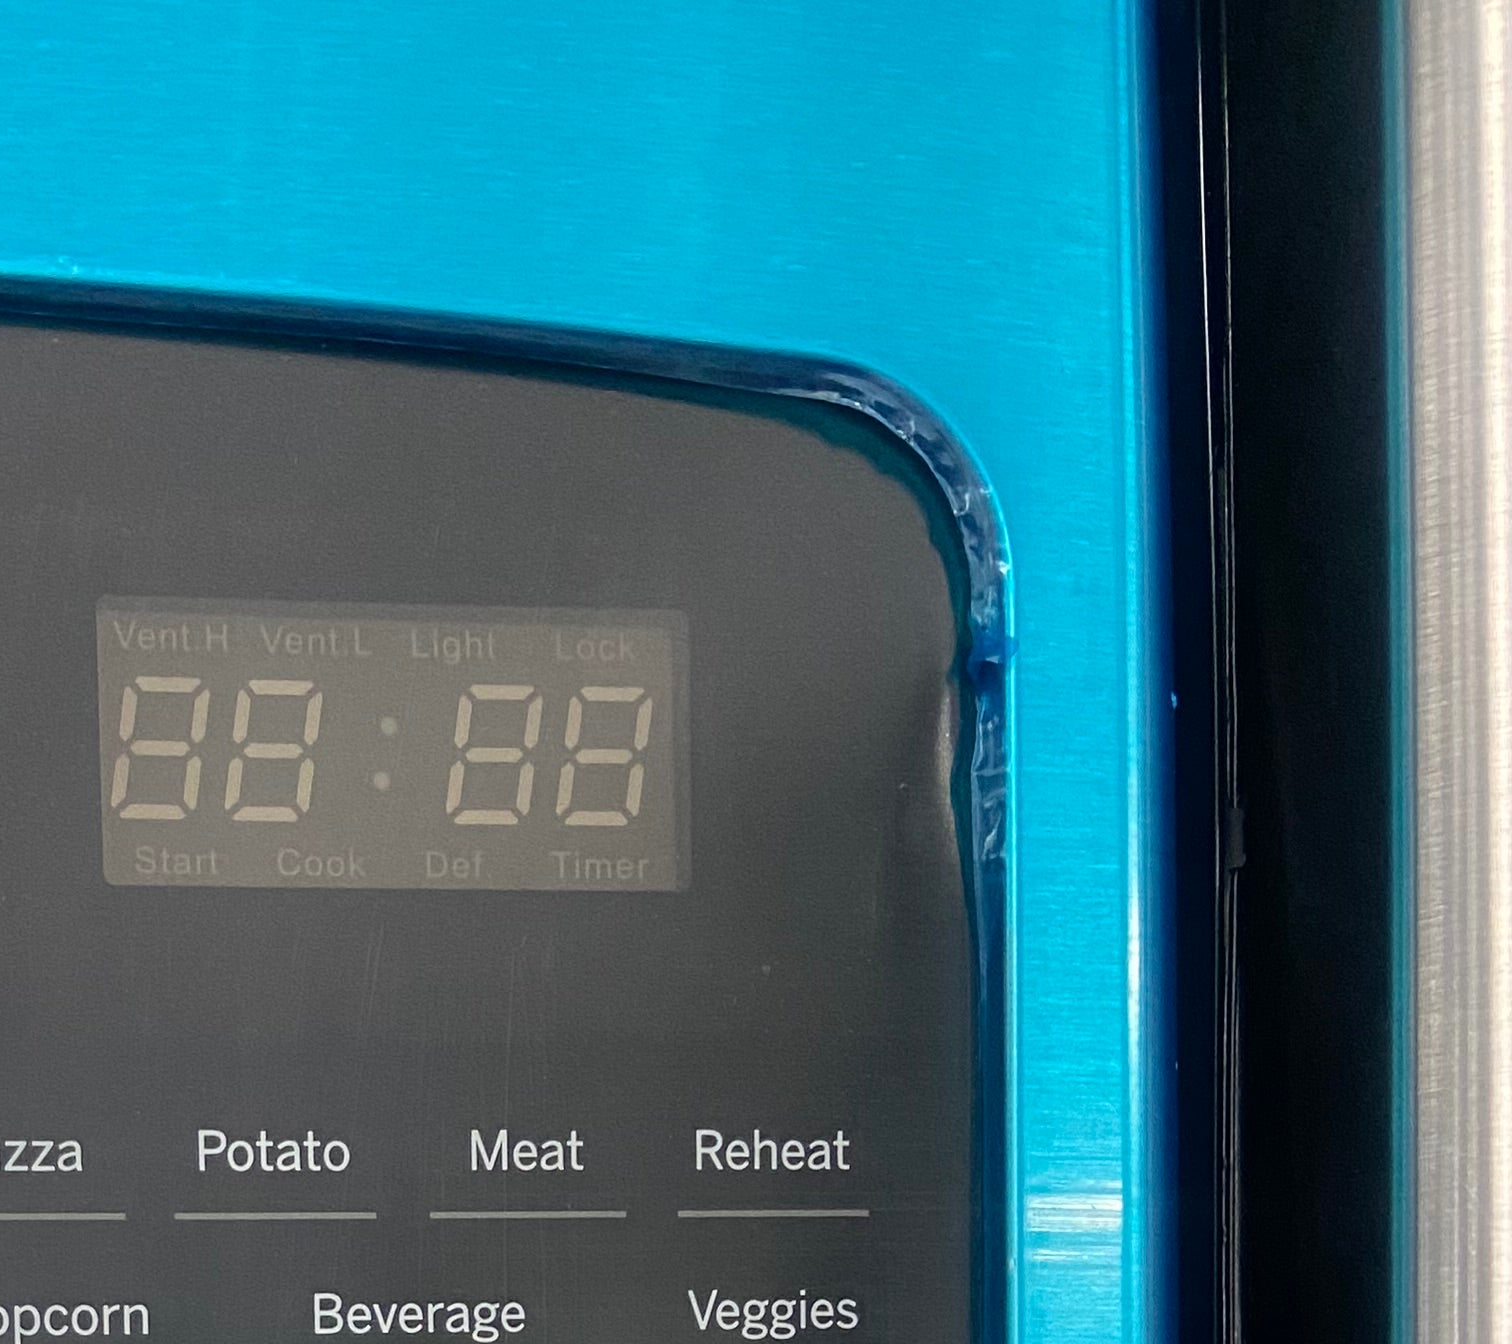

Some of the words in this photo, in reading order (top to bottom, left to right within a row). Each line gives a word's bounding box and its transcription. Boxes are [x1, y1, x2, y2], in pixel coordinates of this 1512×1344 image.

[410, 628, 496, 665] Light
[555, 631, 637, 661] Lock
[134, 845, 219, 875] Start
[276, 846, 367, 877] Cook
[549, 850, 651, 881] Timer
[197, 1129, 351, 1172] Potato
[470, 1128, 585, 1171] Meat
[695, 1128, 851, 1171] Reheat
[313, 1292, 526, 1343] Beverage
[687, 1288, 859, 1340] Veggies
